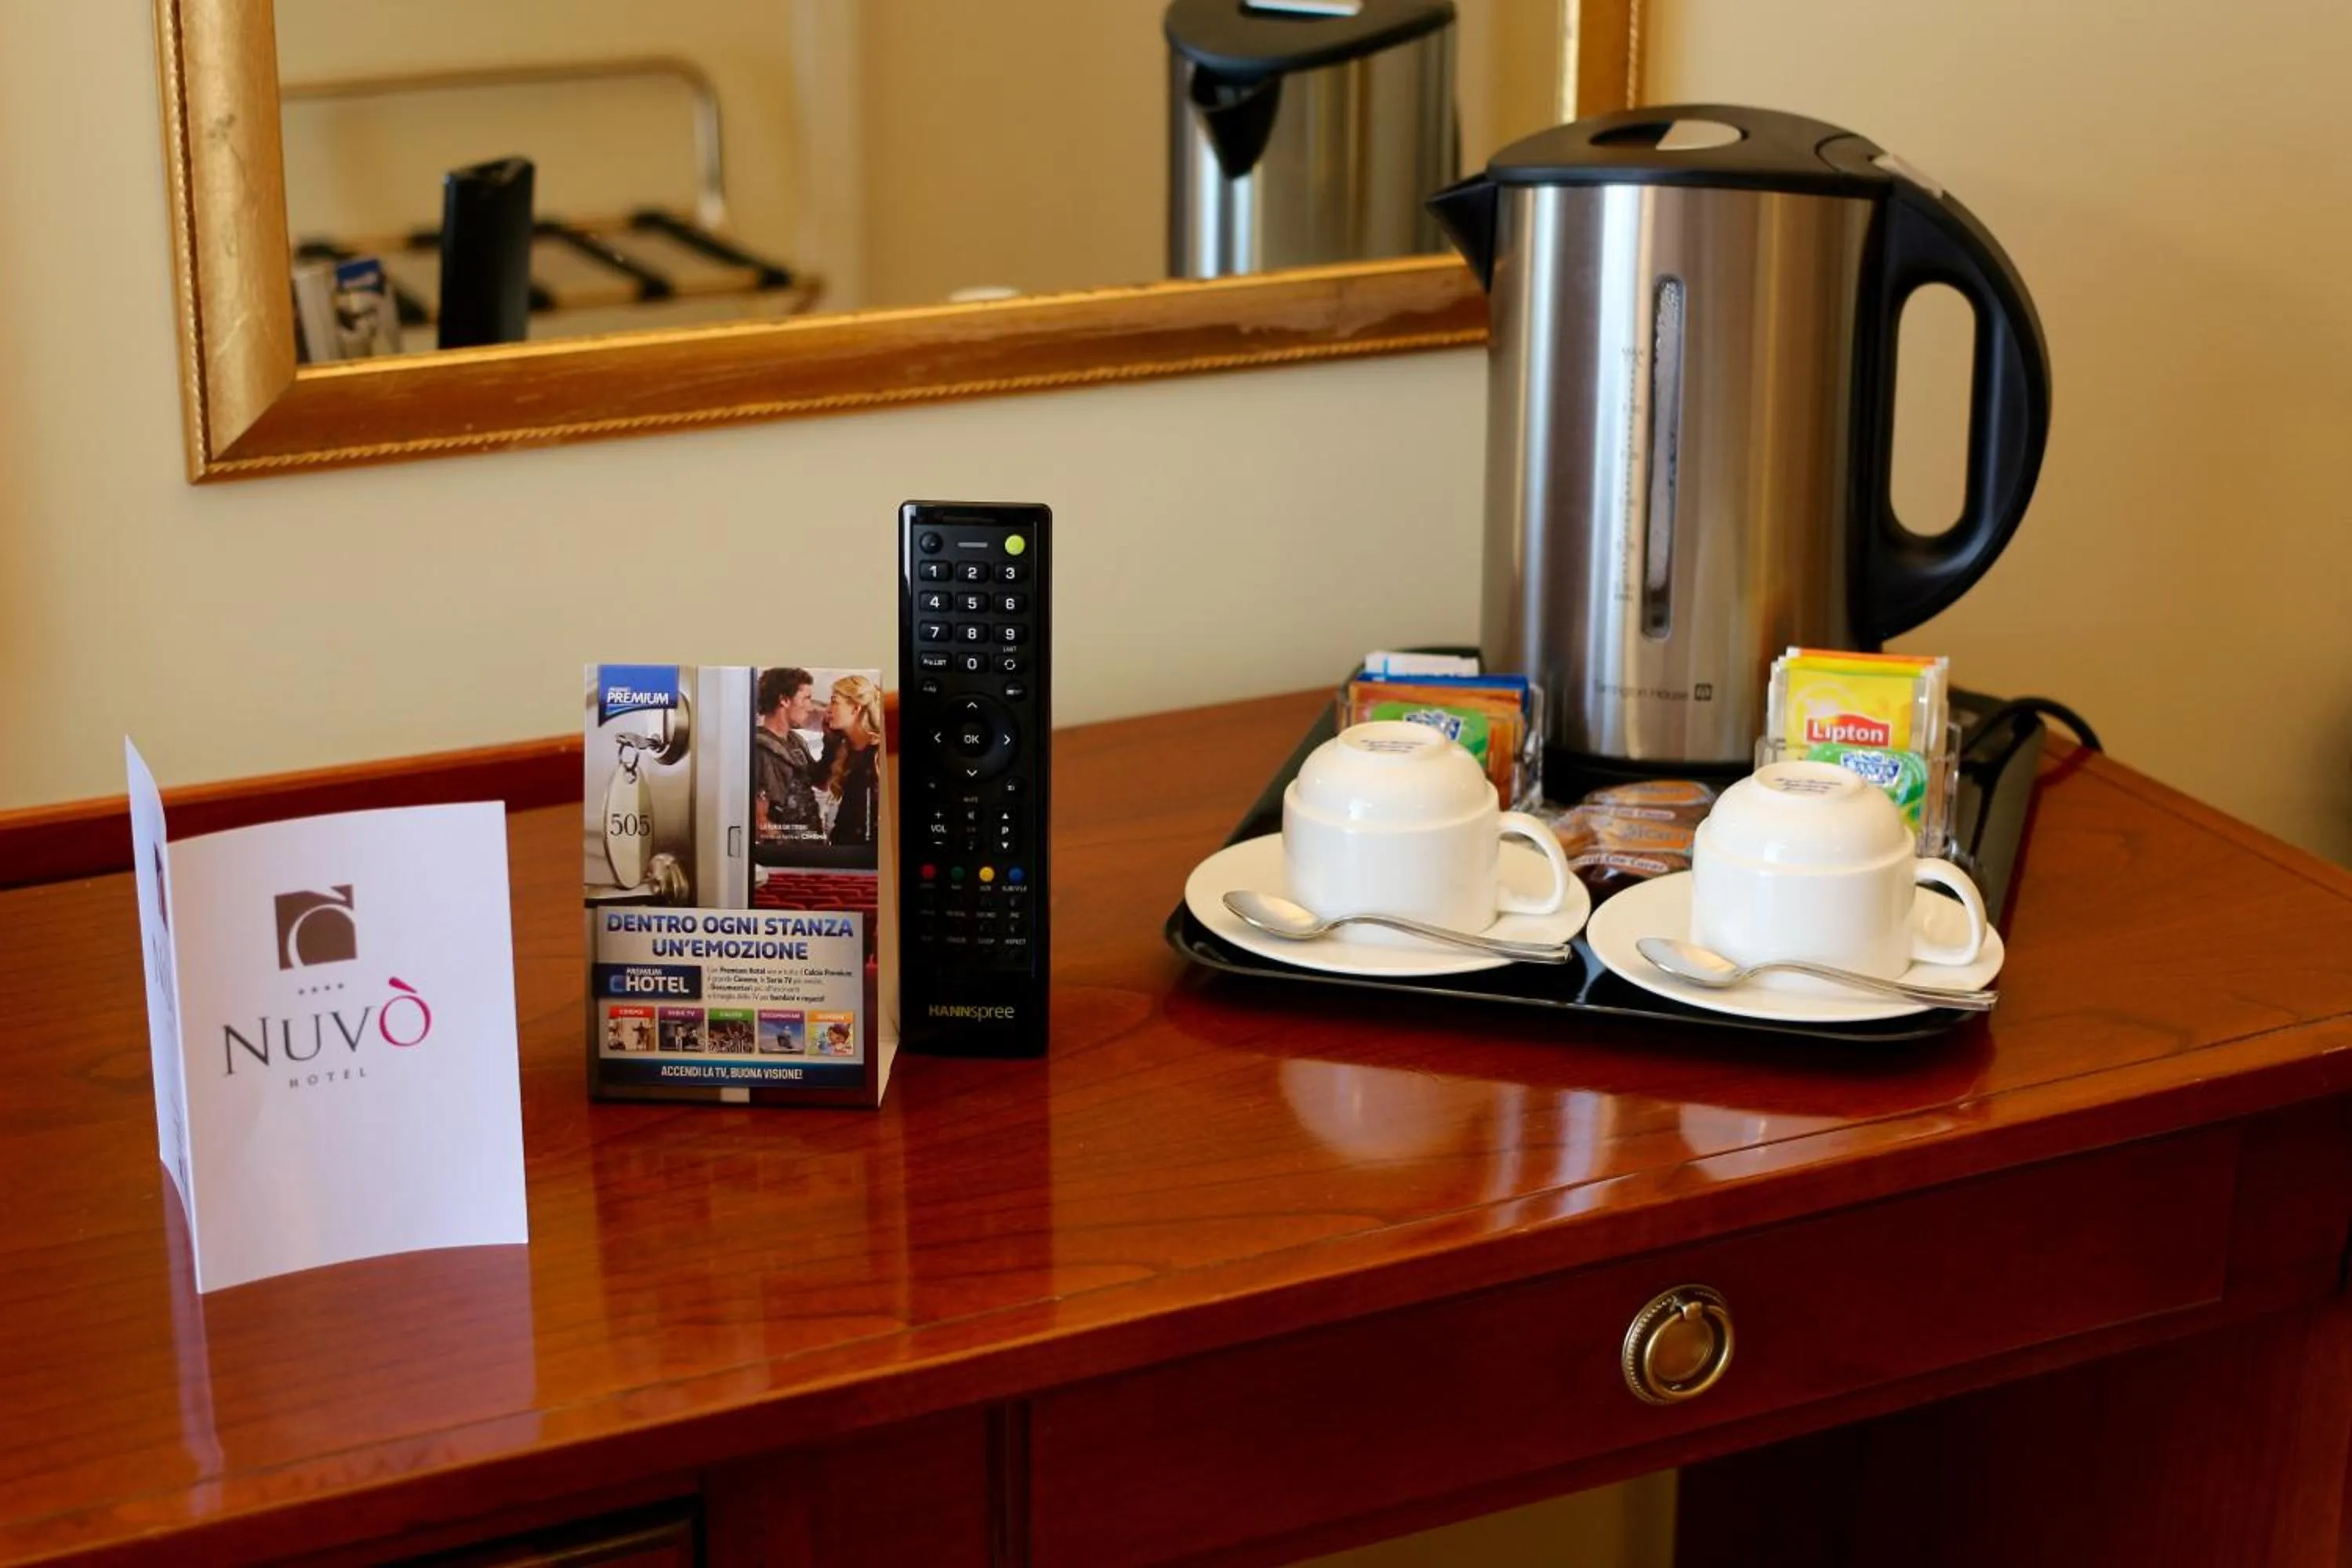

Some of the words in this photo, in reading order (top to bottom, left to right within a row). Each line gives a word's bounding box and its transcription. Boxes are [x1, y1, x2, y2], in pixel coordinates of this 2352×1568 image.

[929, 564, 938, 578] 1
[967, 566, 978, 579] 2
[1005, 567, 1015, 579] 3
[929, 595, 940, 608] 4
[967, 597, 977, 609] 5
[1005, 597, 1015, 610] 6
[931, 626, 940, 639] 7
[967, 627, 977, 641] 8
[1005, 628, 1015, 641] 9
[967, 657, 978, 670] 0
[606, 691, 670, 706] PREMIUM
[1812, 720, 1883, 742] Lipton
[964, 735, 979, 744] OK
[609, 813, 651, 837] 505
[931, 824, 947, 833] VOL
[607, 913, 697, 934] DENTRO
[702, 915, 758, 935] OGNI
[764, 917, 854, 938] STANZA
[652, 938, 808, 960] UN'EMOZIONE
[626, 967, 662, 976] PREMIUM
[626, 976, 690, 993] HOTEL
[928, 1004, 1015, 1022] HANNspree
[223, 976, 432, 1077] NUVÒ
[289, 1066, 368, 1089] HOTEL
[661, 1065, 701, 1078] ACCENDI
[702, 1066, 714, 1078] LA
[731, 1068, 763, 1079] BUONA
[763, 1068, 803, 1080] VISIONE!
